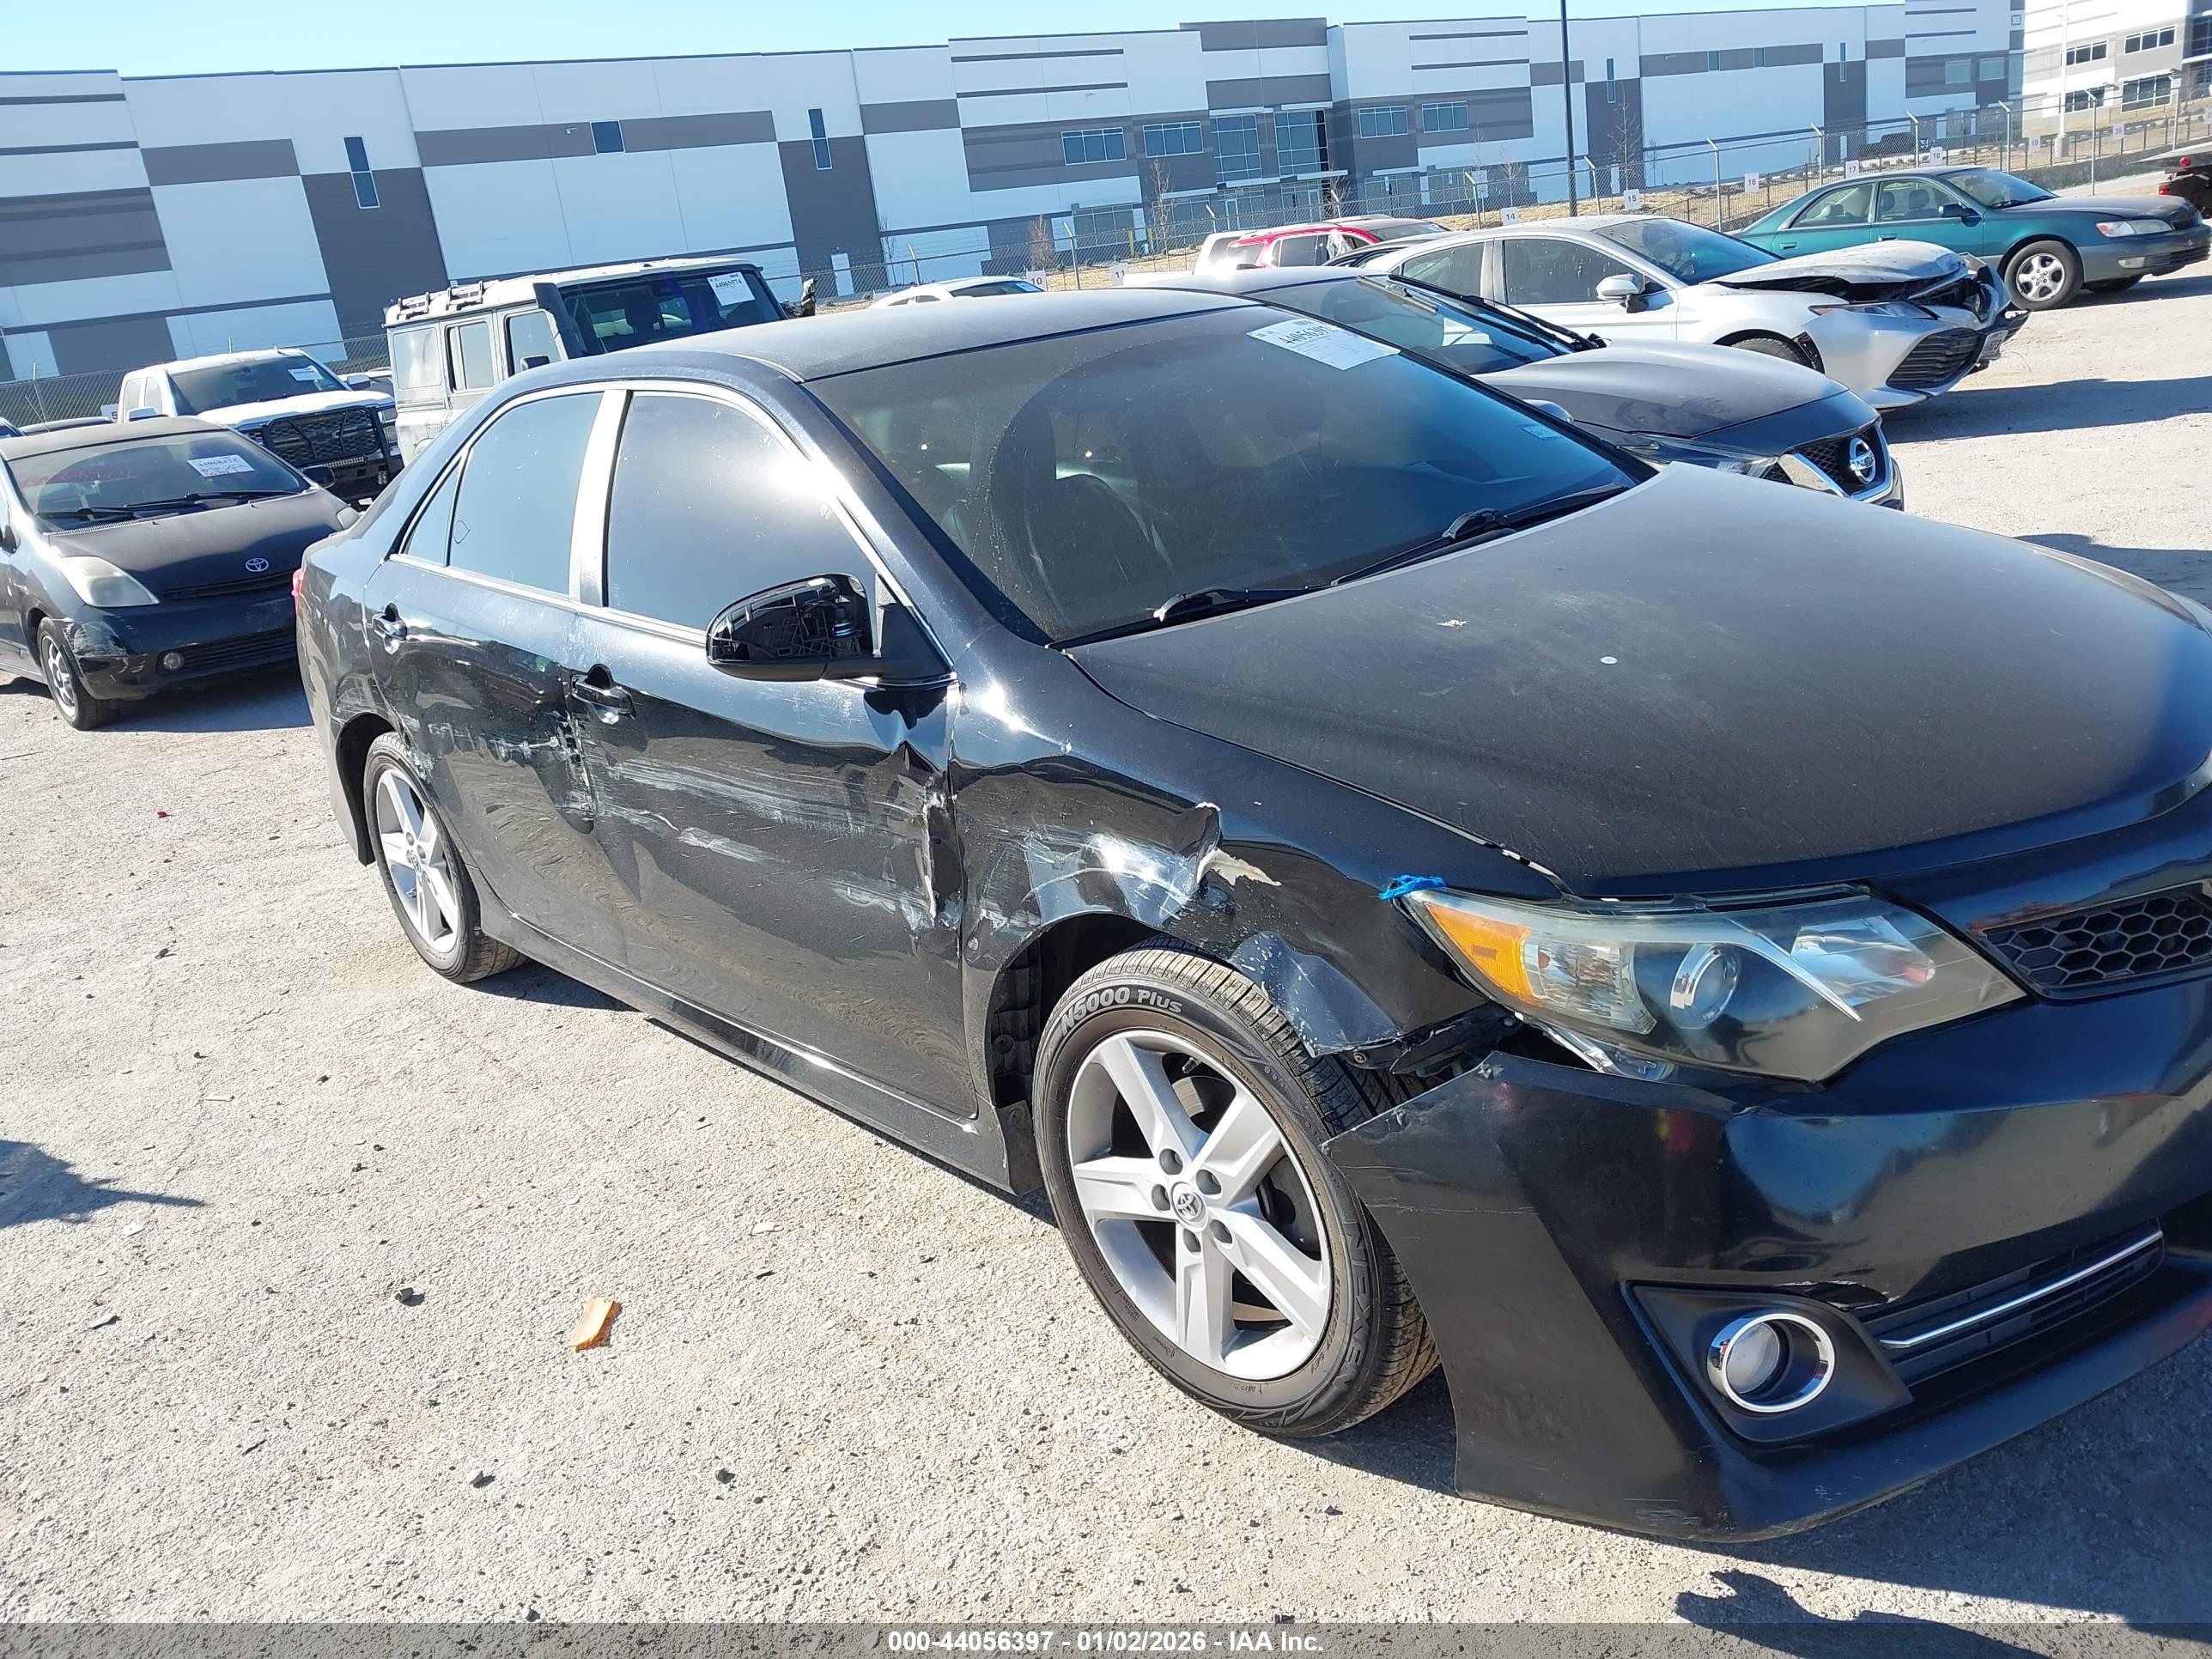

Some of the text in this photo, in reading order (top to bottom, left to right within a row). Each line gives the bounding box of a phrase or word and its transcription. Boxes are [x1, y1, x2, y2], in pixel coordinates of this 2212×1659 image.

[1627, 194, 1636, 203] 15
[1506, 212, 1516, 221] 14
[1115, 270, 1125, 279] 11
[1031, 276, 1042, 285] 10
[1060, 987, 1183, 1036] N5000 Plus
[1333, 1223, 1371, 1385] NEXEN
